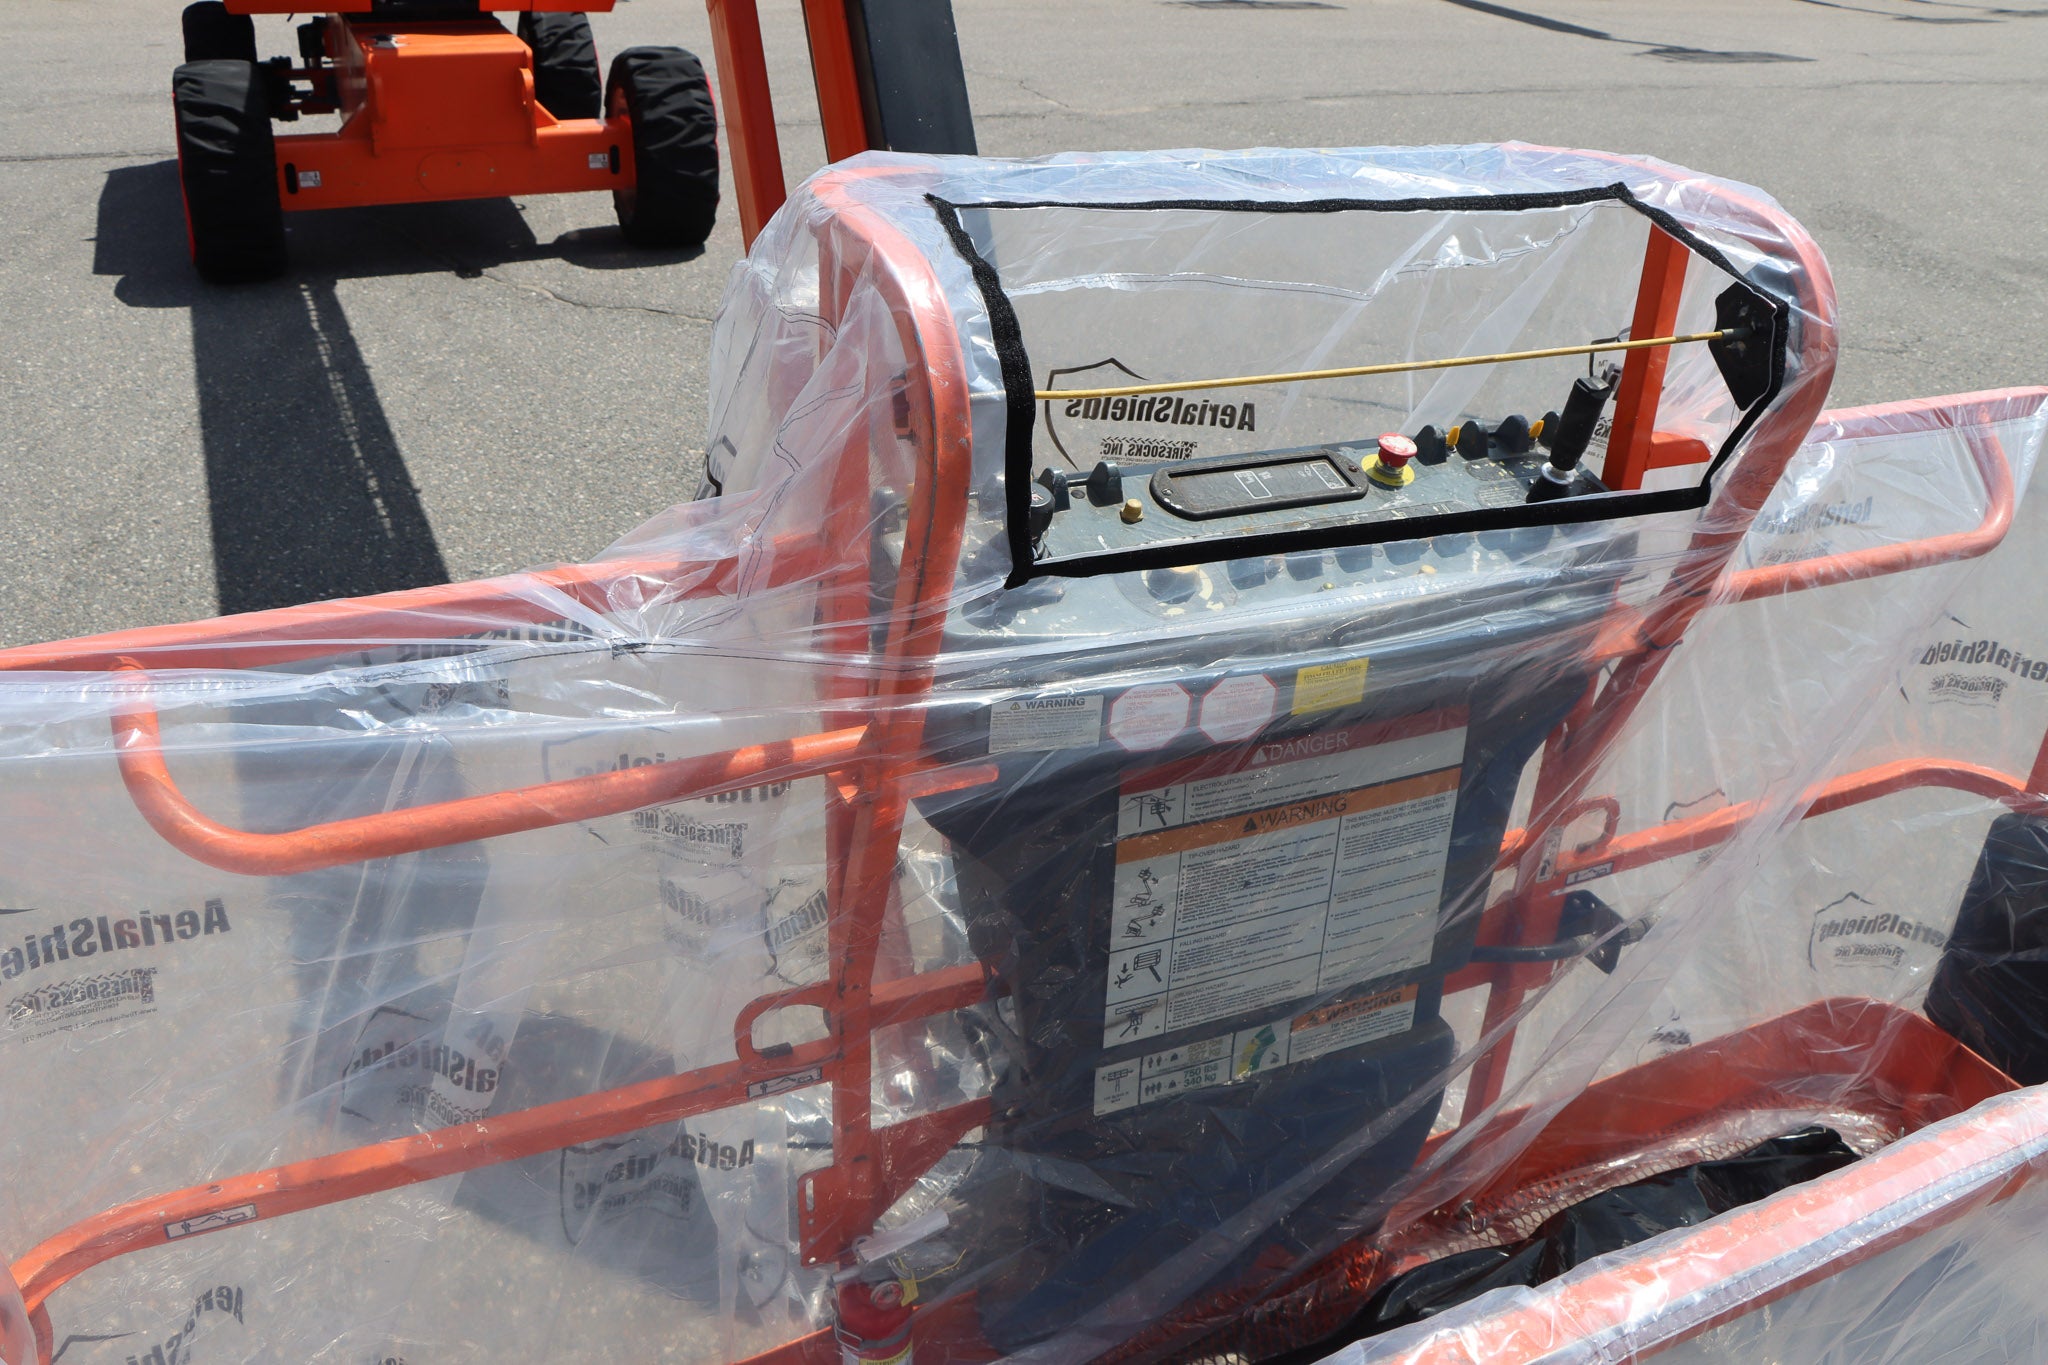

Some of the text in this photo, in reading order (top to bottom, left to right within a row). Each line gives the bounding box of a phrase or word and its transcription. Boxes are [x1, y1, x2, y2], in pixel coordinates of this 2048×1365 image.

[1025, 696, 1086, 710] WARNING
[1268, 731, 1350, 762] DANGER
[1260, 797, 1348, 829] WARNING
[1216, 843, 1241, 854] HAZARD
[1179, 931, 1228, 948] FALLING HAZARD
[1205, 981, 1229, 992] HAZARD
[1326, 991, 1402, 1021] WARNING
[1208, 1047, 1222, 1057] kg
[1183, 1068, 1202, 1079] 750
[1204, 1062, 1219, 1073] lbs
[1183, 1072, 1217, 1088] 340 kg
